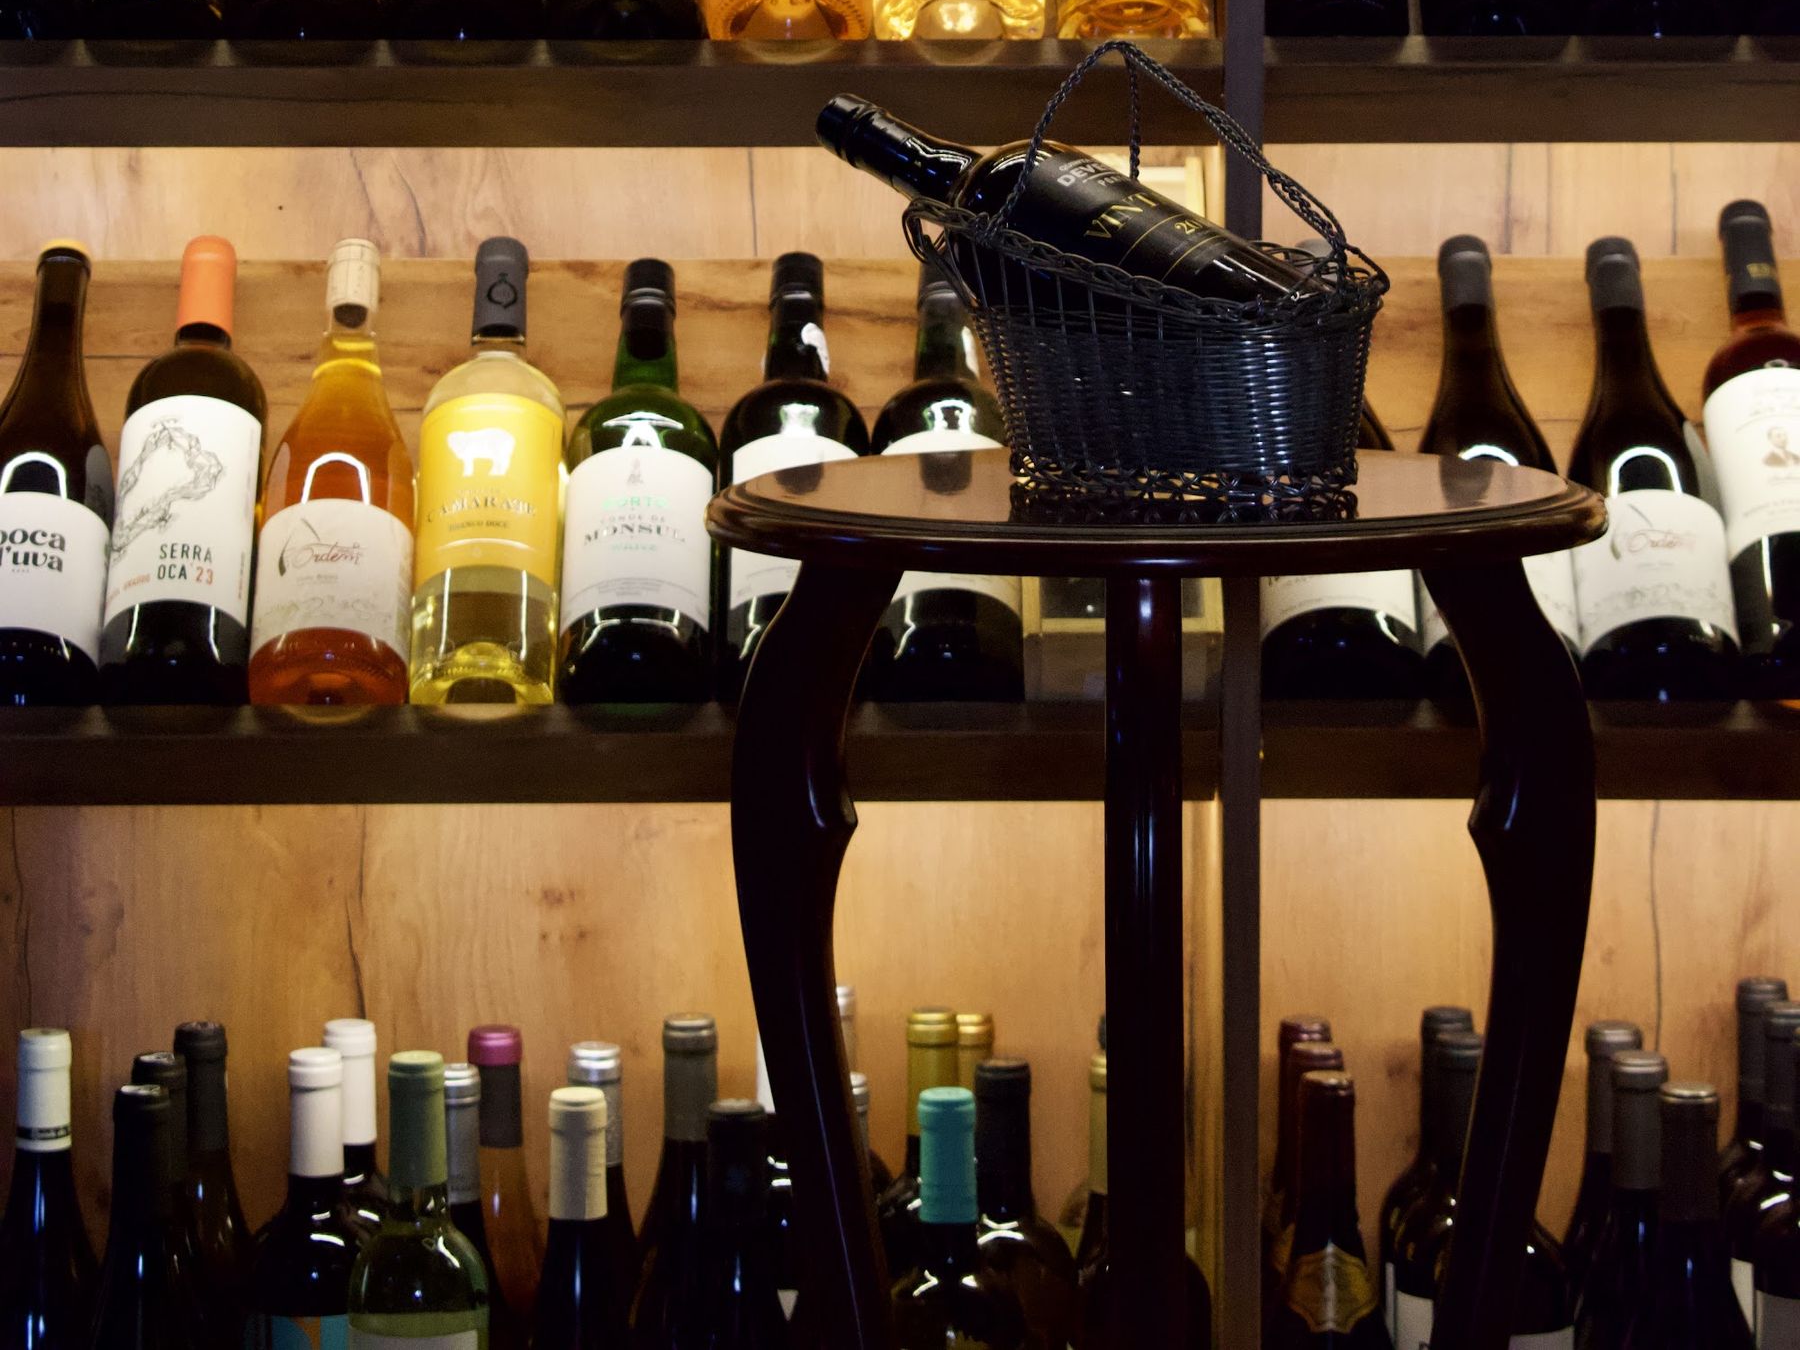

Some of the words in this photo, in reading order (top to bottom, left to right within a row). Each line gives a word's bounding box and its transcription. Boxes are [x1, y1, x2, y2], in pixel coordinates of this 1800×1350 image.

[0, 546, 63, 573] 'uva
[159, 542, 213, 564] SERRA
[157, 563, 188, 580] OCA
